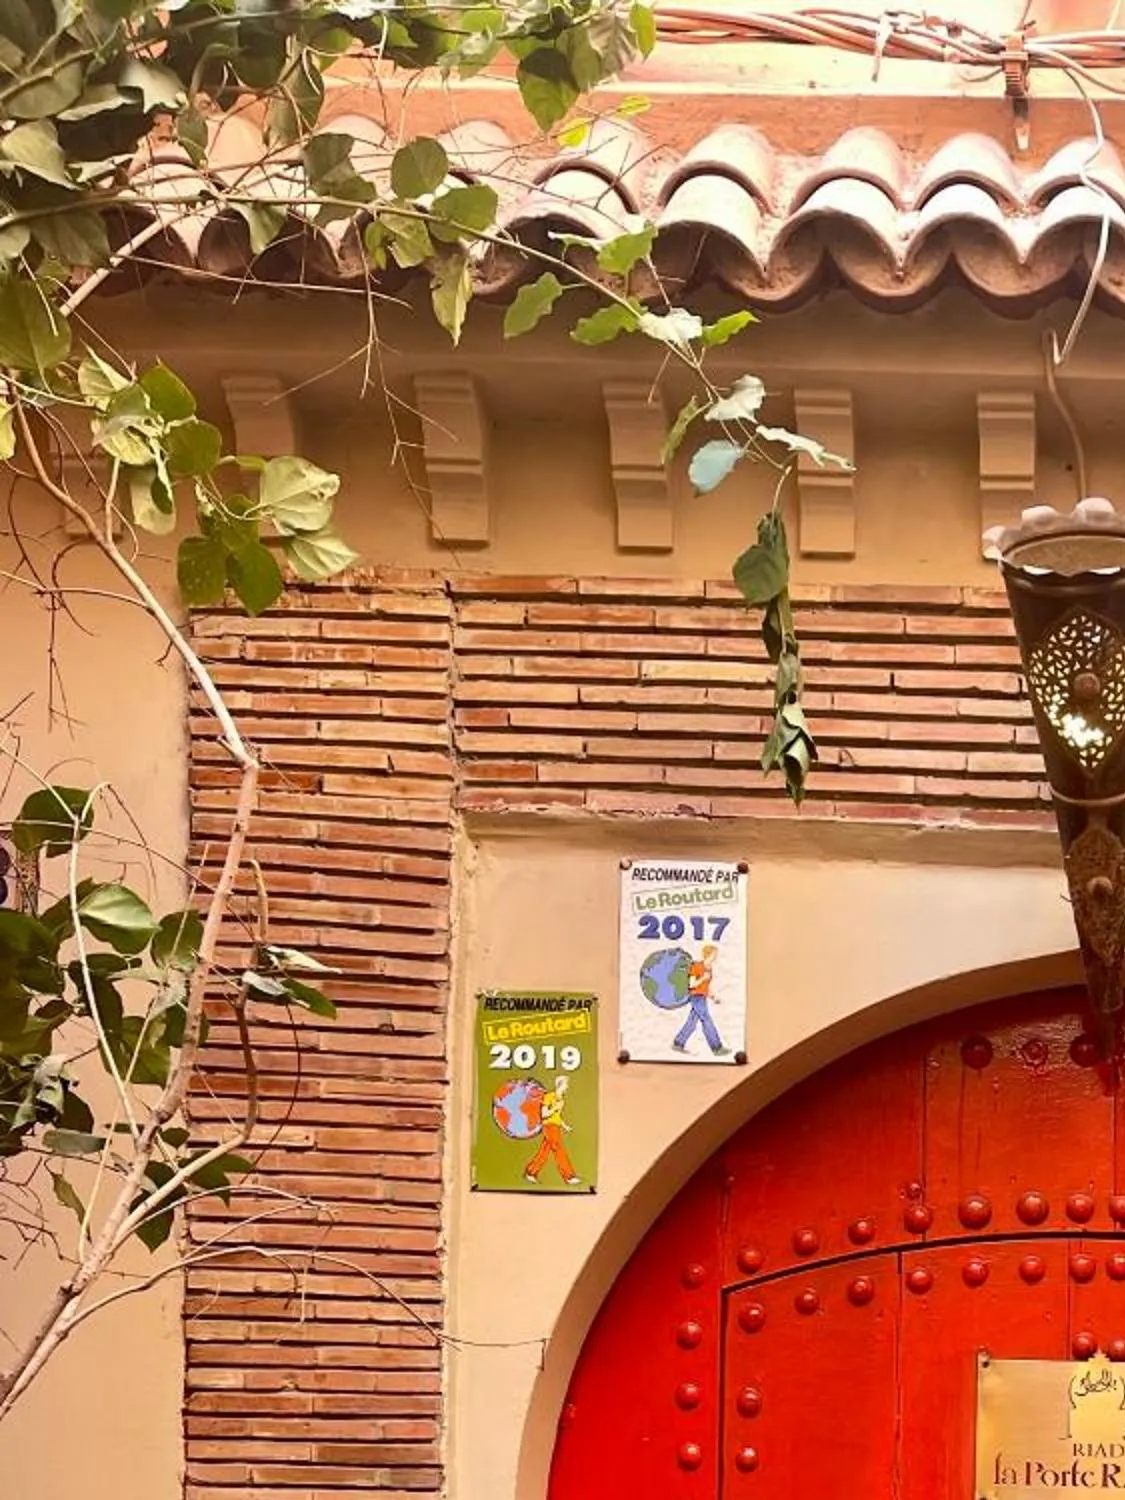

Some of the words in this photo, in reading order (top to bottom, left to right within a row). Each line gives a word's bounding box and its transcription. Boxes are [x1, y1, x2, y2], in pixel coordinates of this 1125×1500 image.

[716, 870, 739, 884] PAR
[635, 895, 657, 910] Le
[658, 882, 733, 907] Routard
[637, 914, 731, 941] 2017
[568, 999, 592, 1012] PAR
[487, 1026, 509, 1041] Le
[509, 1013, 586, 1037] Routard
[488, 1044, 582, 1071] 2019
[1073, 1443, 1125, 1458] RIAD
[994, 1451, 1017, 1485] la
[1025, 1459, 1096, 1487] Porte
